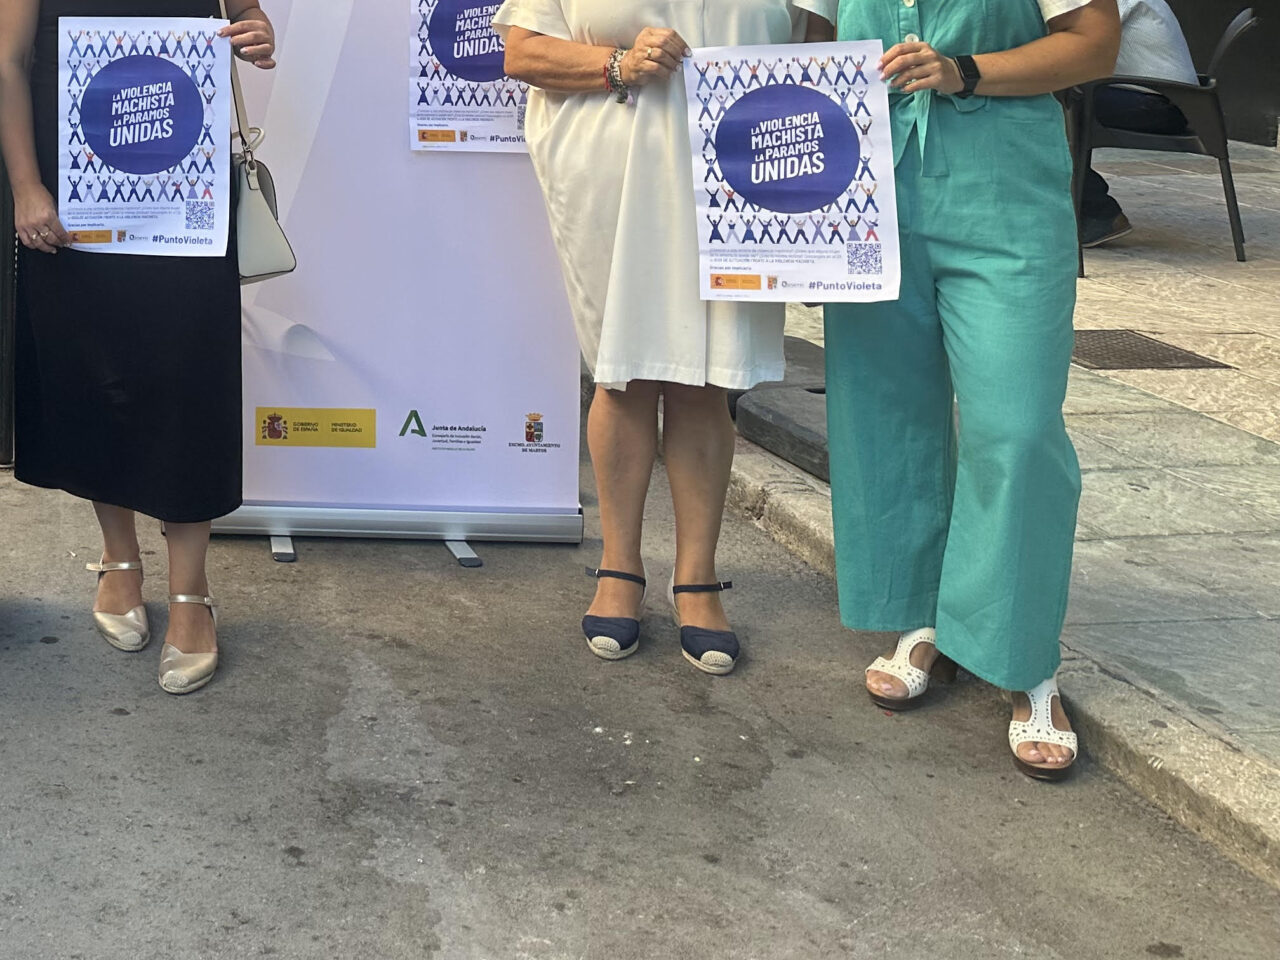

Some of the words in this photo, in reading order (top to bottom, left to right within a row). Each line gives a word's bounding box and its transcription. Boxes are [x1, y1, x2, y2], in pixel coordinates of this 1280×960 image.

[464, 4, 502, 18] VIOLENC
[121, 82, 172, 99] VIOLENCIA
[112, 93, 174, 115] MACHISTA
[122, 108, 170, 125] PARAMOS
[751, 127, 760, 135] LA
[760, 112, 820, 132] VIOLENCIA
[109, 119, 173, 147] UNIDAS
[751, 125, 824, 149] MACHISTA
[755, 154, 764, 162] LA
[766, 140, 819, 160] PARAMOS
[751, 152, 825, 184] UNIDAS
[152, 235, 213, 245] #PuntoVioleta
[809, 281, 882, 290] #PuntoVioleta
